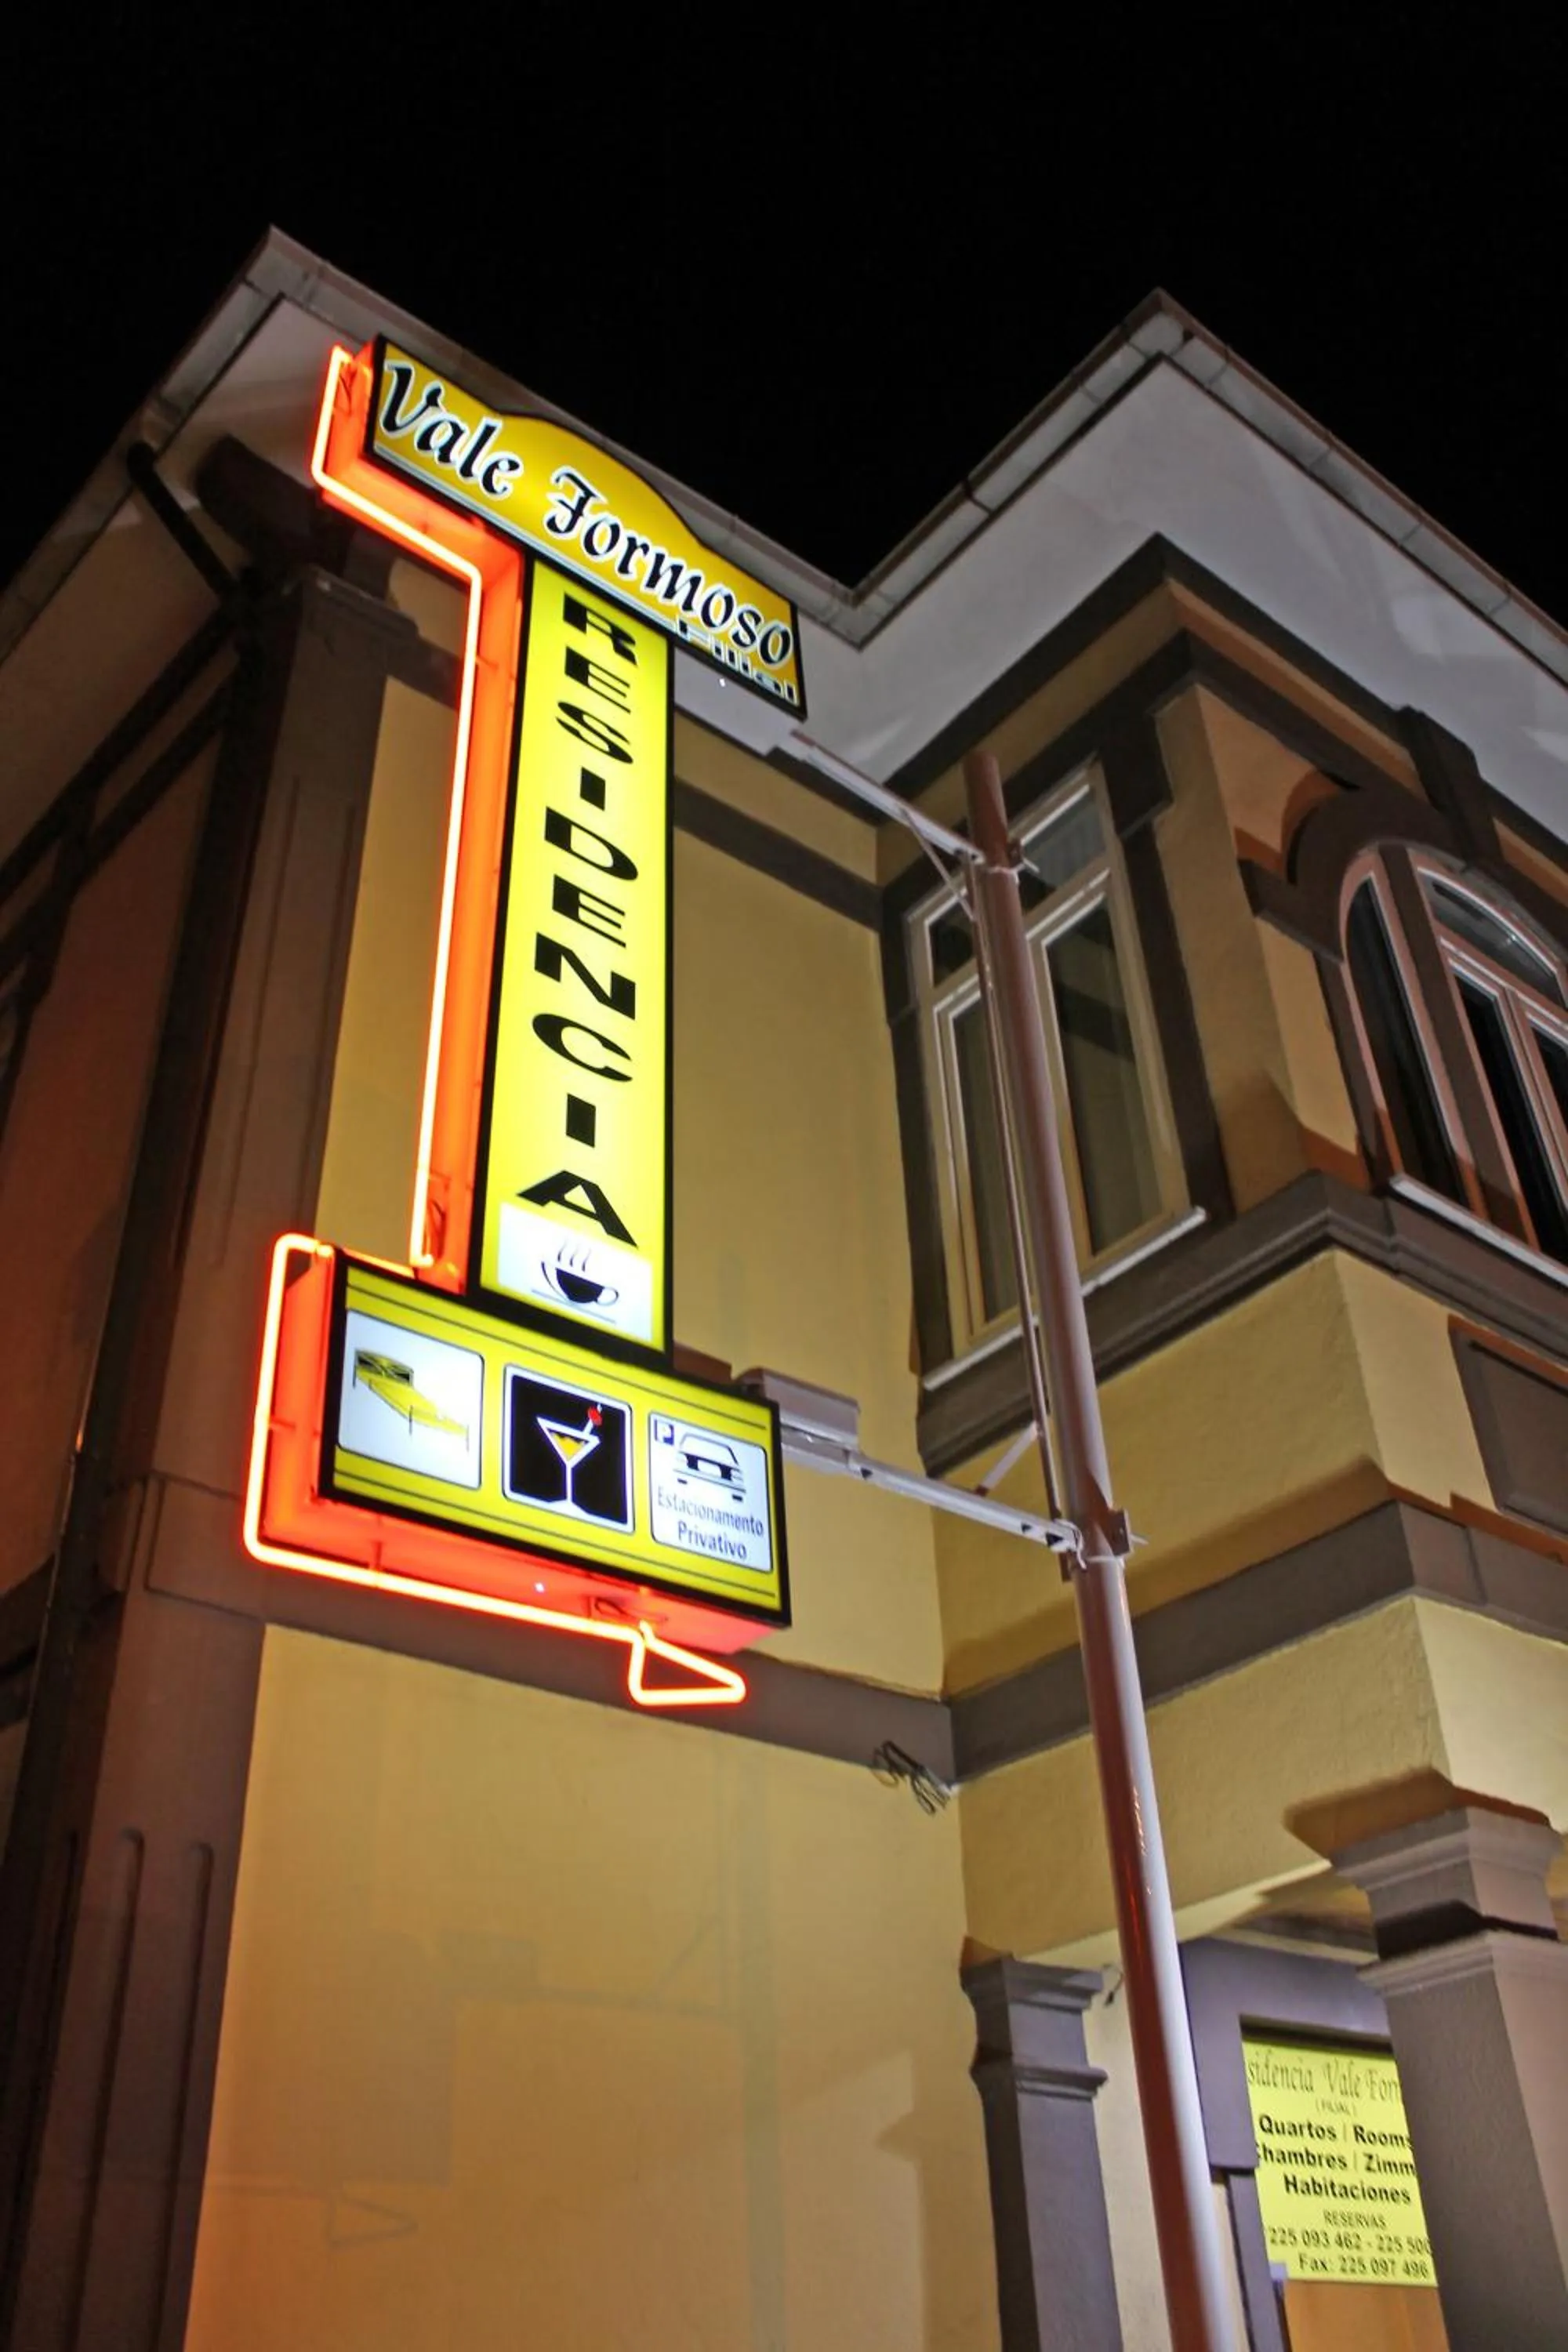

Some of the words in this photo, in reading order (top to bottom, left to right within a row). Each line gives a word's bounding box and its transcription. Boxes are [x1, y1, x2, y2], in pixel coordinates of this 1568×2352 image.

[383, 361, 523, 499] Vale
[543, 466, 793, 667] Formoso
[517, 593, 638, 1247] RESIDENCIA
[657, 1486, 764, 1537] Estacionamento
[677, 1521, 747, 1559] Privativo
[1323, 2057, 1360, 2099] Vale
[1259, 2114, 1337, 2140] Quartos
[1283, 2172, 1411, 2205] Habitaciones
[1323, 2209, 1386, 2230] RESERVAS
[1269, 2226, 1298, 2246] 225
[1301, 2228, 1330, 2249] 093
[1376, 2234, 1403, 2253] 225
[1339, 2254, 1367, 2274] 225
